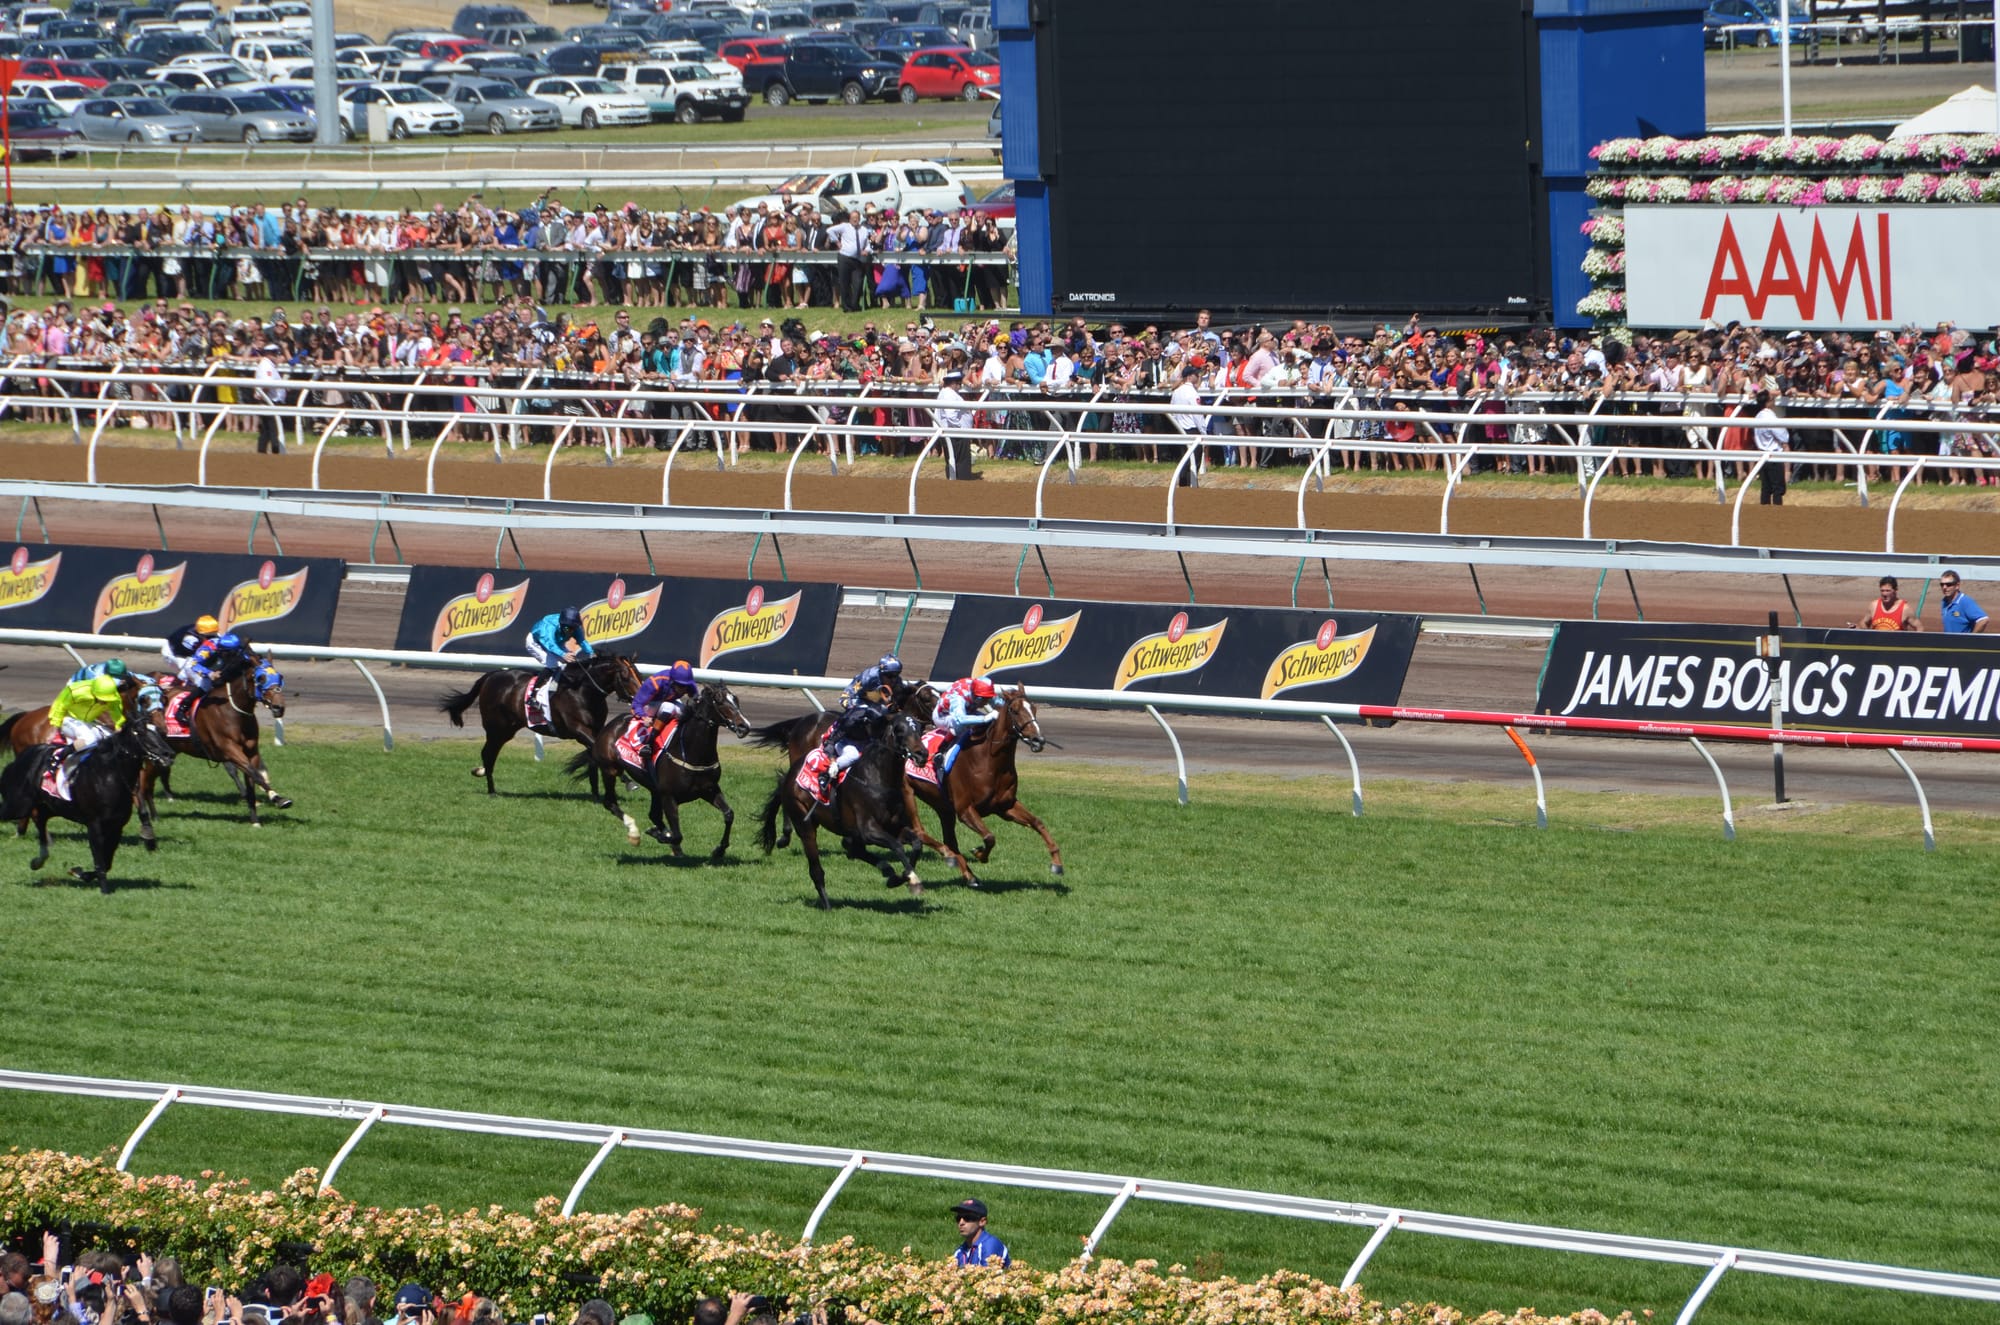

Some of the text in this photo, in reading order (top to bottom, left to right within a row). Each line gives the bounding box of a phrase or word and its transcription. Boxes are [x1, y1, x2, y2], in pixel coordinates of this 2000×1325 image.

[1700, 211, 1893, 322] AAMI
[1068, 292, 1116, 302] DAKTRONICS
[0, 572, 47, 600] hweppes
[104, 581, 172, 615] Schweppes
[227, 588, 294, 623] Schweppes
[443, 601, 514, 638] Schweppes
[711, 609, 788, 652] Schweppes
[983, 629, 1065, 670] Schweppes
[1127, 637, 1212, 678] Schweppes
[1273, 644, 1361, 687] Schweppes
[1560, 651, 2000, 722] JAMES BOAG'S PREMI
